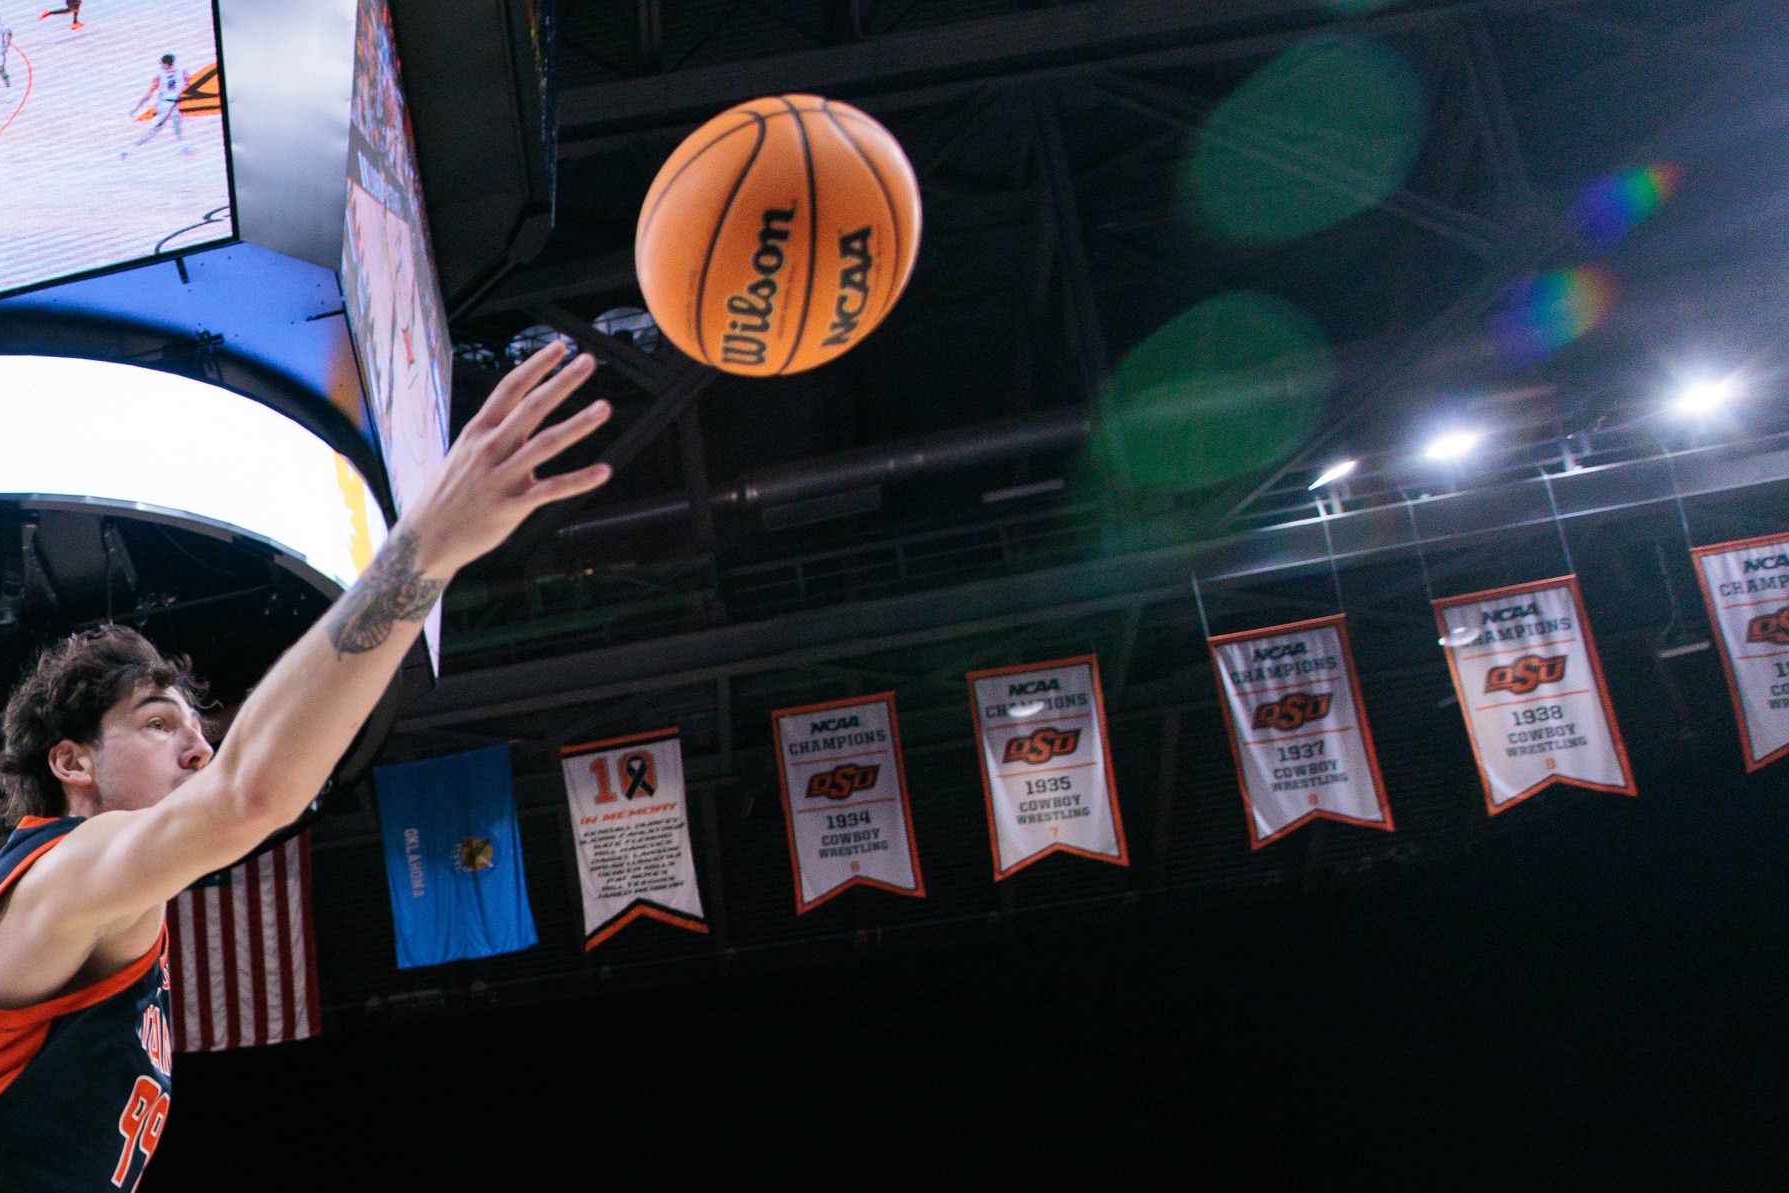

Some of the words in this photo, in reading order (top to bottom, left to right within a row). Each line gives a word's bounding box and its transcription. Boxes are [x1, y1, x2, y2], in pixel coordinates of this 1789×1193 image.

[721, 199, 801, 366] Wilson
[820, 224, 872, 348] NCAA
[1482, 601, 1542, 625] NCAA
[1483, 653, 1569, 695] OSU
[1009, 678, 1061, 697] NCAA
[810, 715, 861, 735] NCAA
[1512, 704, 1564, 727] 1938
[788, 729, 887, 756] CHAMPIONS
[1506, 722, 1578, 745] COWBOY
[1001, 727, 1083, 766] OSU
[1276, 740, 1327, 763] 1937
[1504, 736, 1588, 759] WRESTLING
[1273, 759, 1338, 780] COWBOY
[1025, 775, 1072, 795] 1935
[1019, 793, 1081, 814] COWBOY
[826, 809, 871, 829] 1934
[1016, 806, 1091, 825] WRESTLING
[820, 827, 881, 847] COWBOY
[818, 840, 889, 859] WRESTLING
